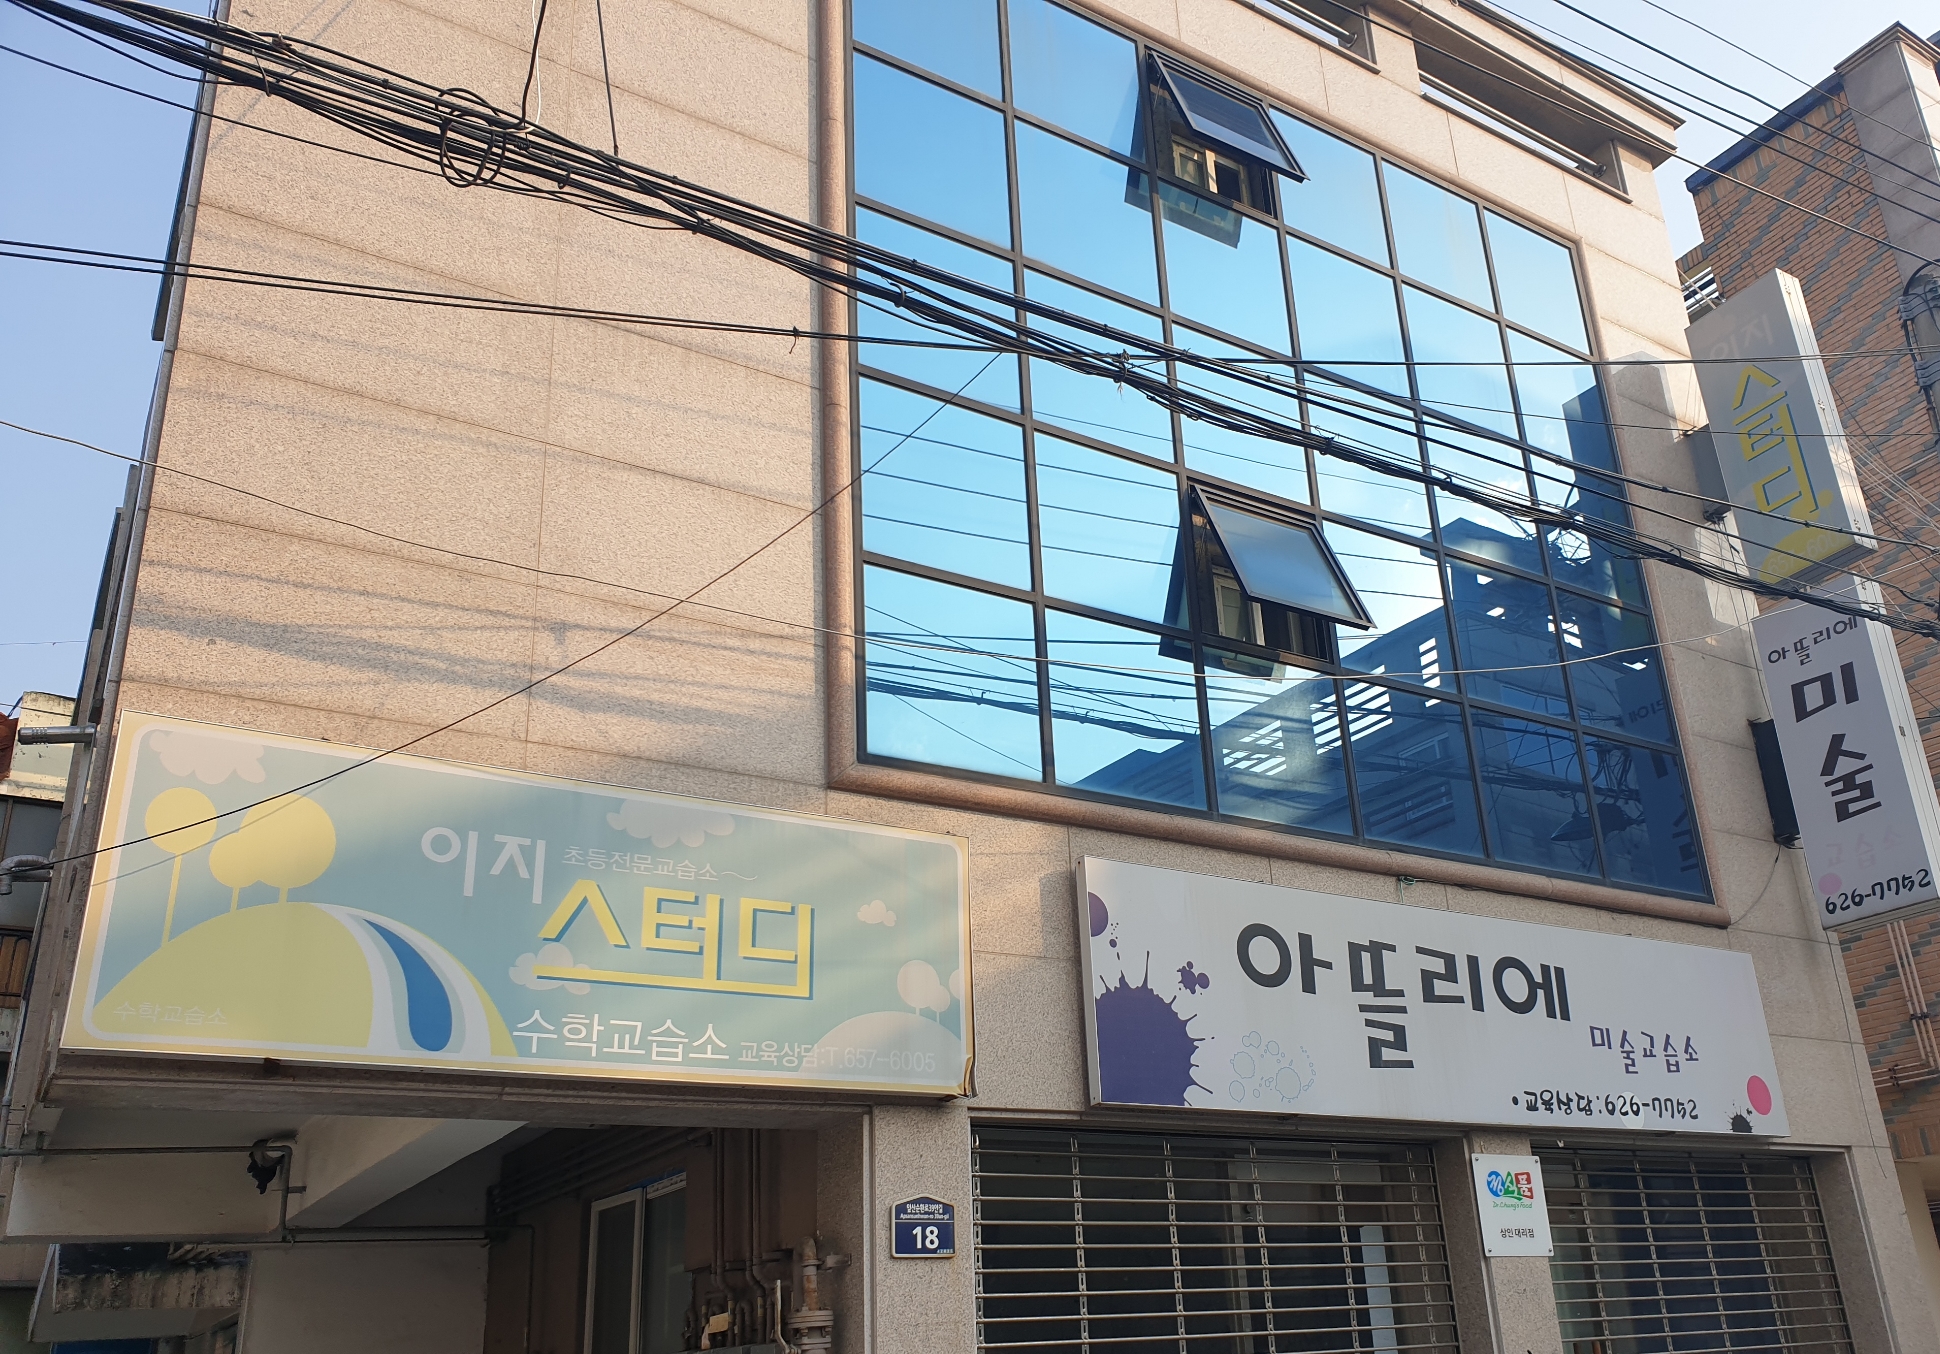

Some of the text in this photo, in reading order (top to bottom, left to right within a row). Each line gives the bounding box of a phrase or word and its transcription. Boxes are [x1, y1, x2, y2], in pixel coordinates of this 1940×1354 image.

[1731, 364, 1819, 514] 스터디
[1767, 615, 1858, 666] 아뜰리에
[1790, 661, 1882, 823] 미술
[421, 827, 546, 904] 이지
[1824, 868, 1931, 914] 626-7752
[532, 878, 815, 999] 스터디
[112, 1000, 228, 1026] 수학교습소
[1236, 922, 1572, 1069] 아뜰리에
[512, 1009, 730, 1063] 수학교습소
[1590, 1025, 1699, 1075] 미술교습소
[1487, 1171, 1534, 1200] 정식품
[912, 1226, 939, 1249] 18
[1500, 1228, 1535, 1238] 상인 대리점
